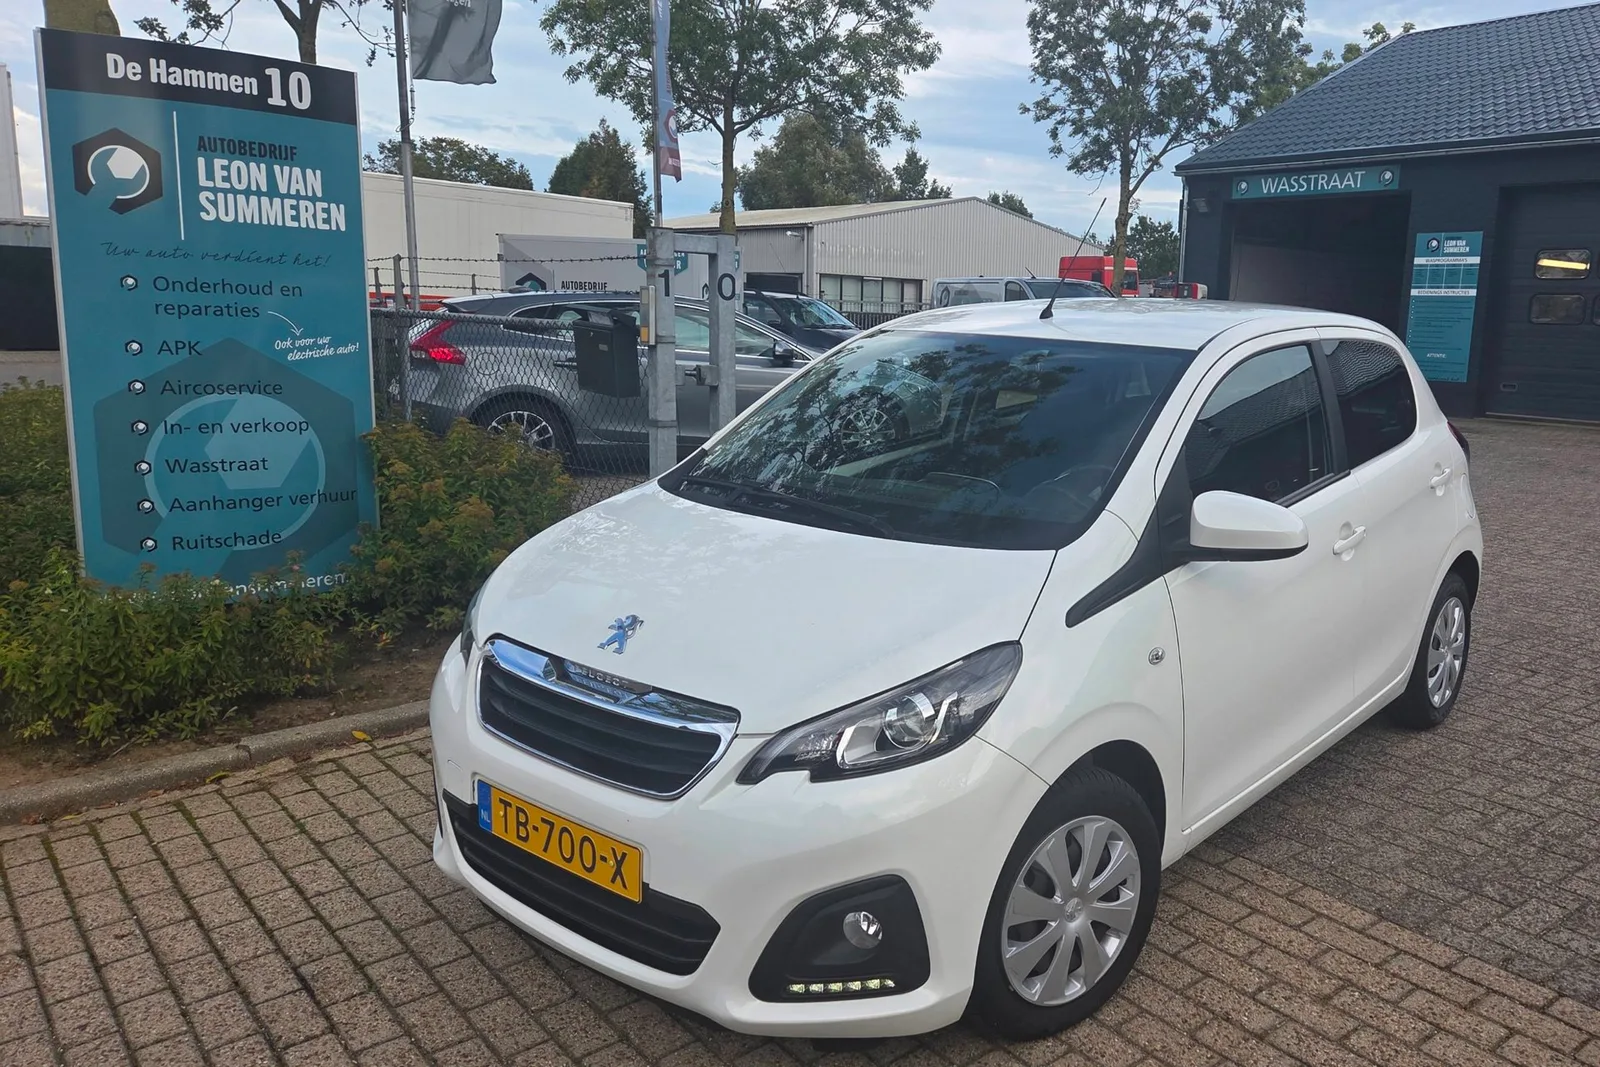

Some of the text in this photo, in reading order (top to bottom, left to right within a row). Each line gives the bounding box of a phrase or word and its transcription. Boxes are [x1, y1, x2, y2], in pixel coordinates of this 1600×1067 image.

[106, 53, 312, 110] De Hammen 10
[197, 135, 297, 162] AUTOBEDRIJF
[197, 157, 323, 197] LEON VAN
[1261, 171, 1366, 194] WASSTRAAT
[199, 191, 346, 231] SUMMEREN
[100, 241, 332, 268] Uw auto verdient het!
[152, 276, 303, 297] Onderhoud en
[561, 280, 608, 291] AUTOBEDRIJF
[155, 300, 260, 320] reparaties
[157, 340, 202, 356] APK
[274, 336, 332, 350] Ook voor uw
[287, 342, 360, 361] electrische auto!
[160, 380, 283, 396] Aircoservice
[163, 418, 310, 436] In- en verkoop
[165, 456, 269, 474] Wasstraat
[169, 488, 358, 513] Aanhanger verhuur
[172, 530, 282, 550] Ruitschade
[481, 808, 491, 823] NL
[498, 797, 629, 890] TB-700-X
